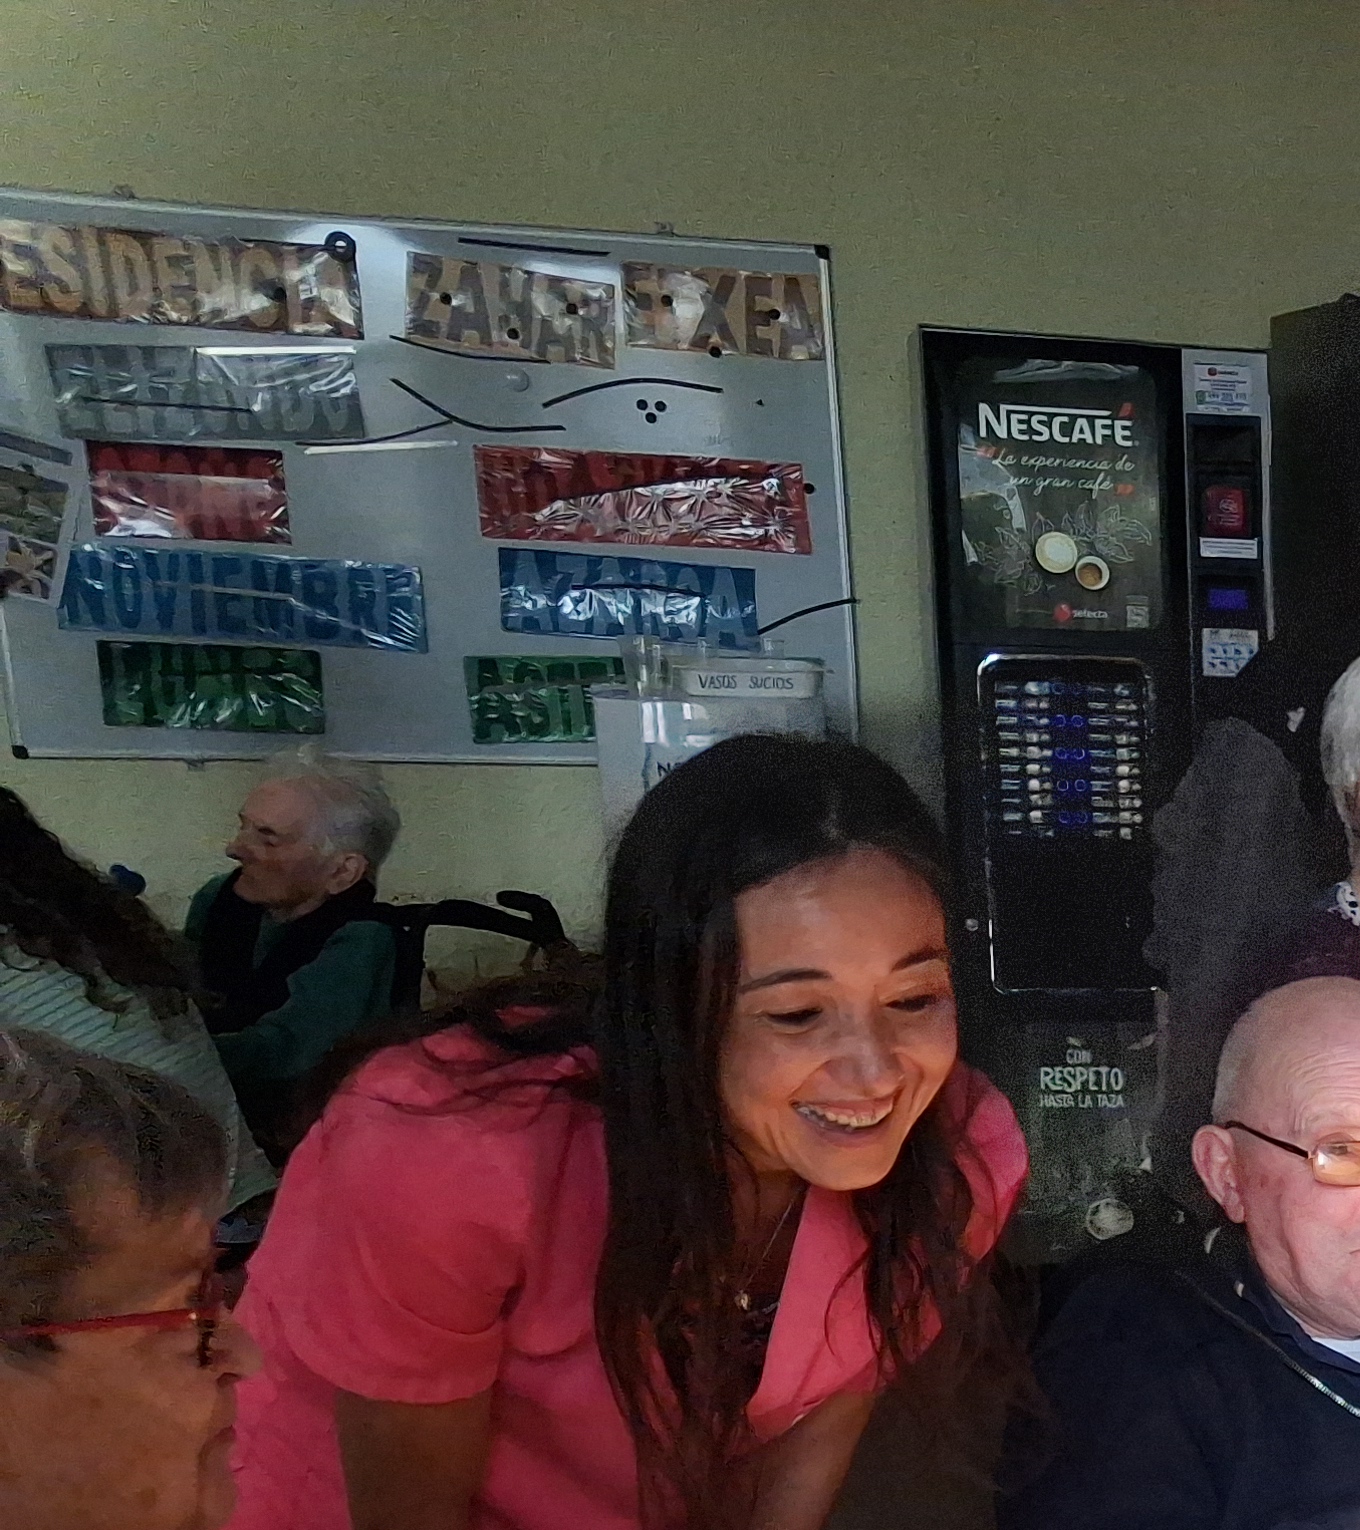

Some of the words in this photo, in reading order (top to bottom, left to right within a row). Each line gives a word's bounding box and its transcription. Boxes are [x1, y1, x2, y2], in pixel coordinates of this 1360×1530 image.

[698, 673, 738, 690] VASOS
[749, 675, 795, 690] SUCIOS
[1040, 1066, 1124, 1092] RESPETO
[1079, 1094, 1094, 1108] LA
